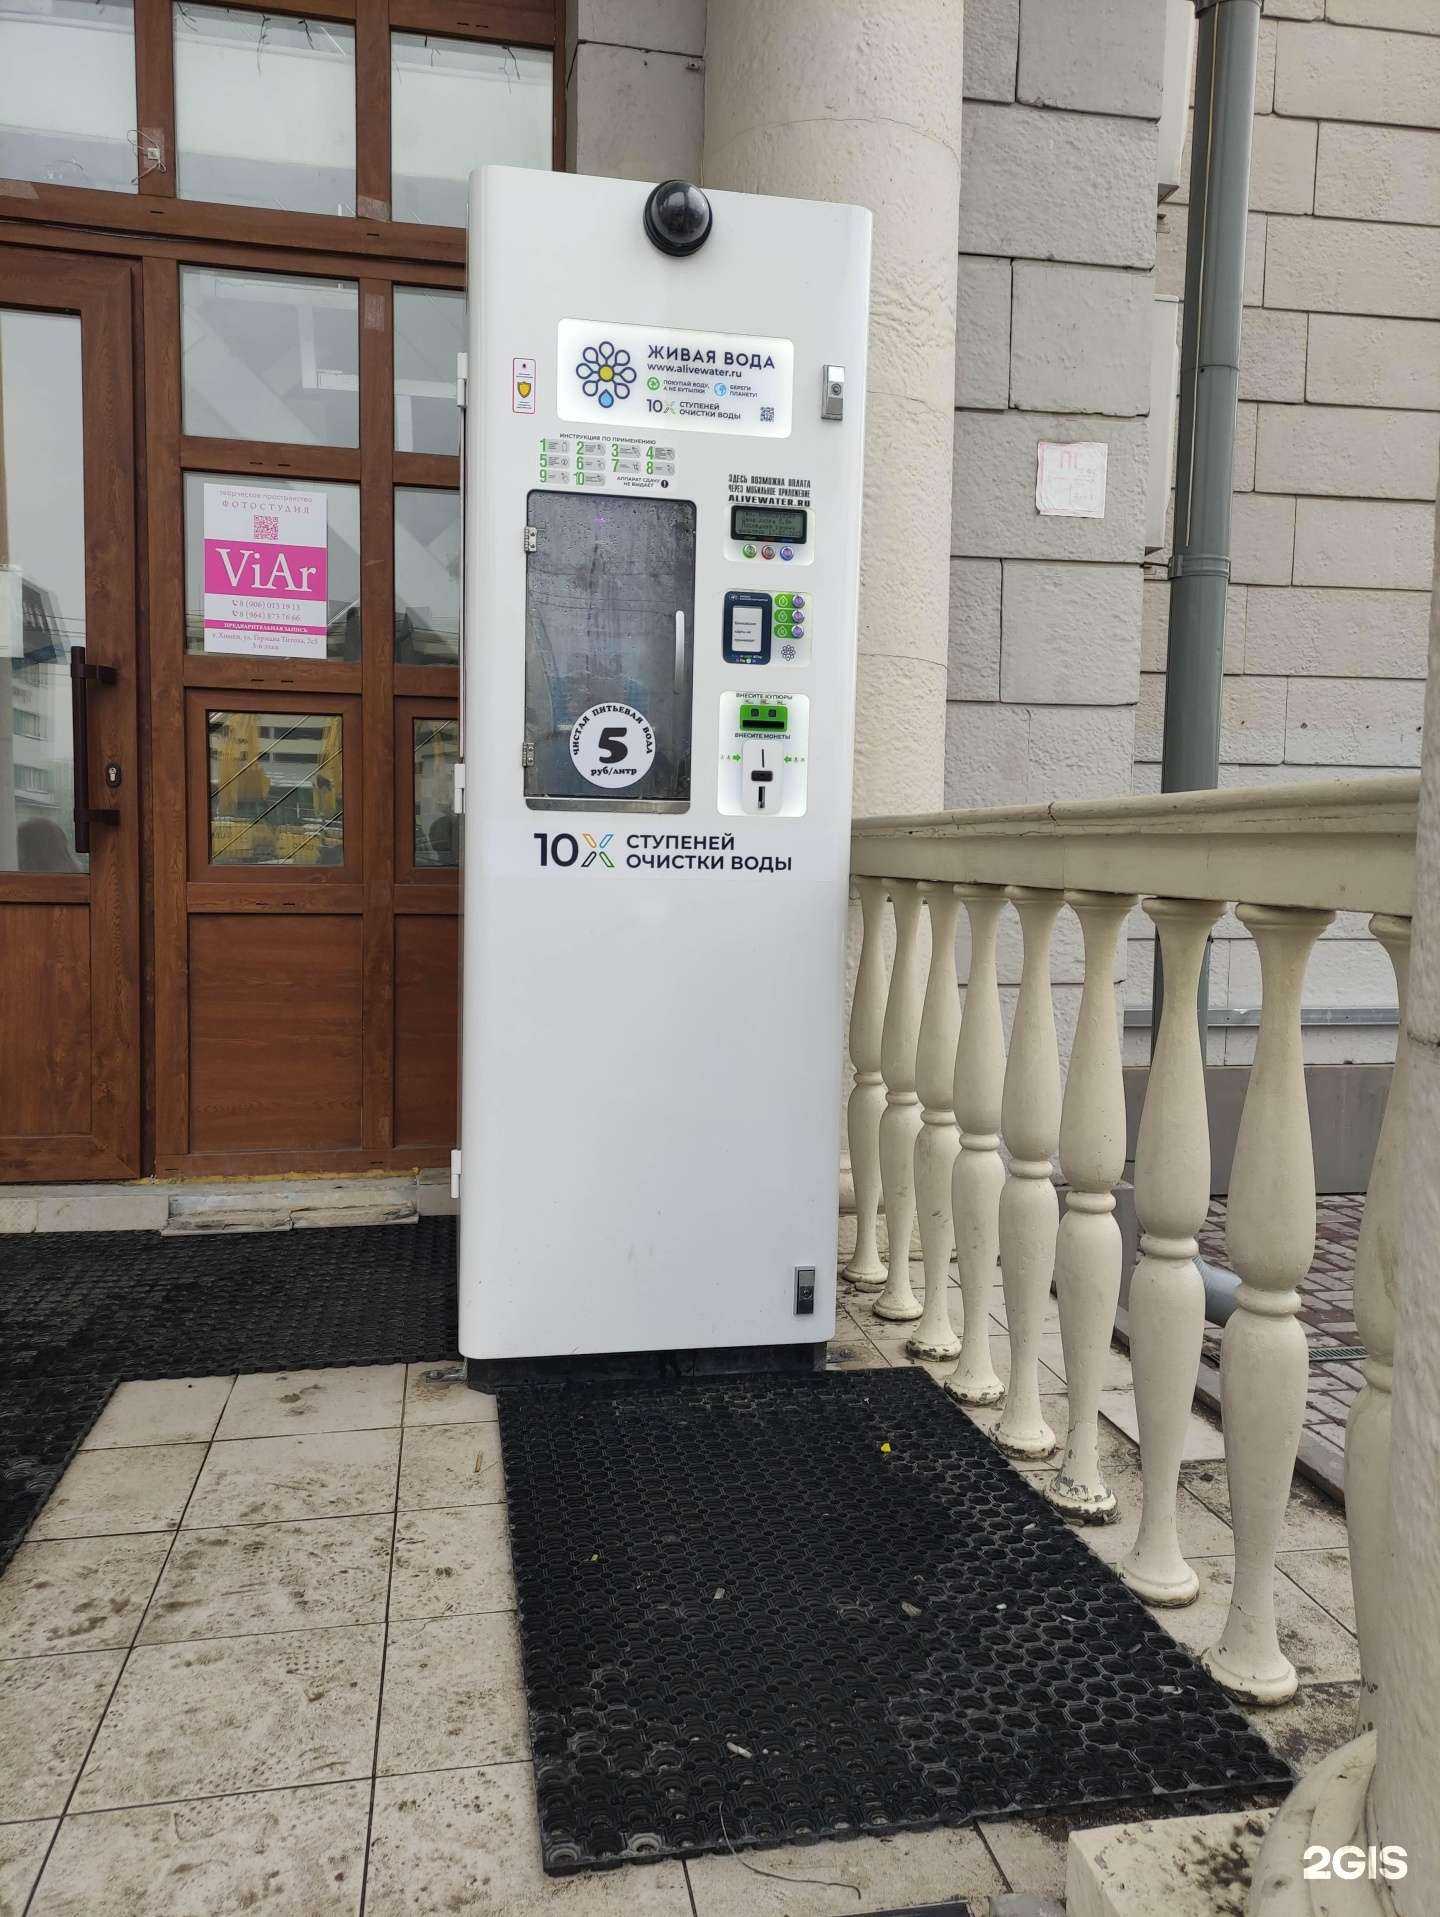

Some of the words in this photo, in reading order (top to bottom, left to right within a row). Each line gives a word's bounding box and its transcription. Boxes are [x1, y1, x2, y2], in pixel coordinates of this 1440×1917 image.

[648, 345, 716, 364] ЖИВАЯ
[724, 352, 775, 370] ВОДА
[647, 363, 742, 378] www.alivewater.ru
[680, 402, 720, 410] СТУПЕНЕЙ
[680, 409, 716, 418] ОЧИСТКИ
[718, 412, 741, 420] ВОДЫ
[540, 438, 547, 452] 1
[576, 441, 584, 455] 2
[611, 444, 619, 457] 3
[646, 446, 654, 460] 4
[540, 454, 547, 468] 5
[576, 456, 584, 470] 6
[611, 459, 620, 472] 7
[646, 461, 654, 475] 8
[540, 470, 547, 483] 9
[574, 472, 584, 486] 10
[728, 474, 748, 484] ЗДЕСЬ
[750, 476, 785, 486] ВОЗМОЖНА
[788, 478, 811, 488] ОПЛАТА
[728, 484, 744, 492] ЧЕРЕЗ
[728, 494, 811, 507] ALIVEWATER.RU
[216, 548, 317, 592] ViAr
[572, 716, 590, 756] ЧИСТАЯ
[592, 705, 644, 724] ПИТЬЕВАЯ
[642, 726, 653, 754] ВОДА
[598, 727, 628, 764] 5
[590, 766, 637, 776] руб/литр
[626, 832, 735, 850] СТУПЕНЕЙ
[626, 854, 724, 870] ОЧИСТКИ
[731, 856, 792, 873] ВОДЫ
